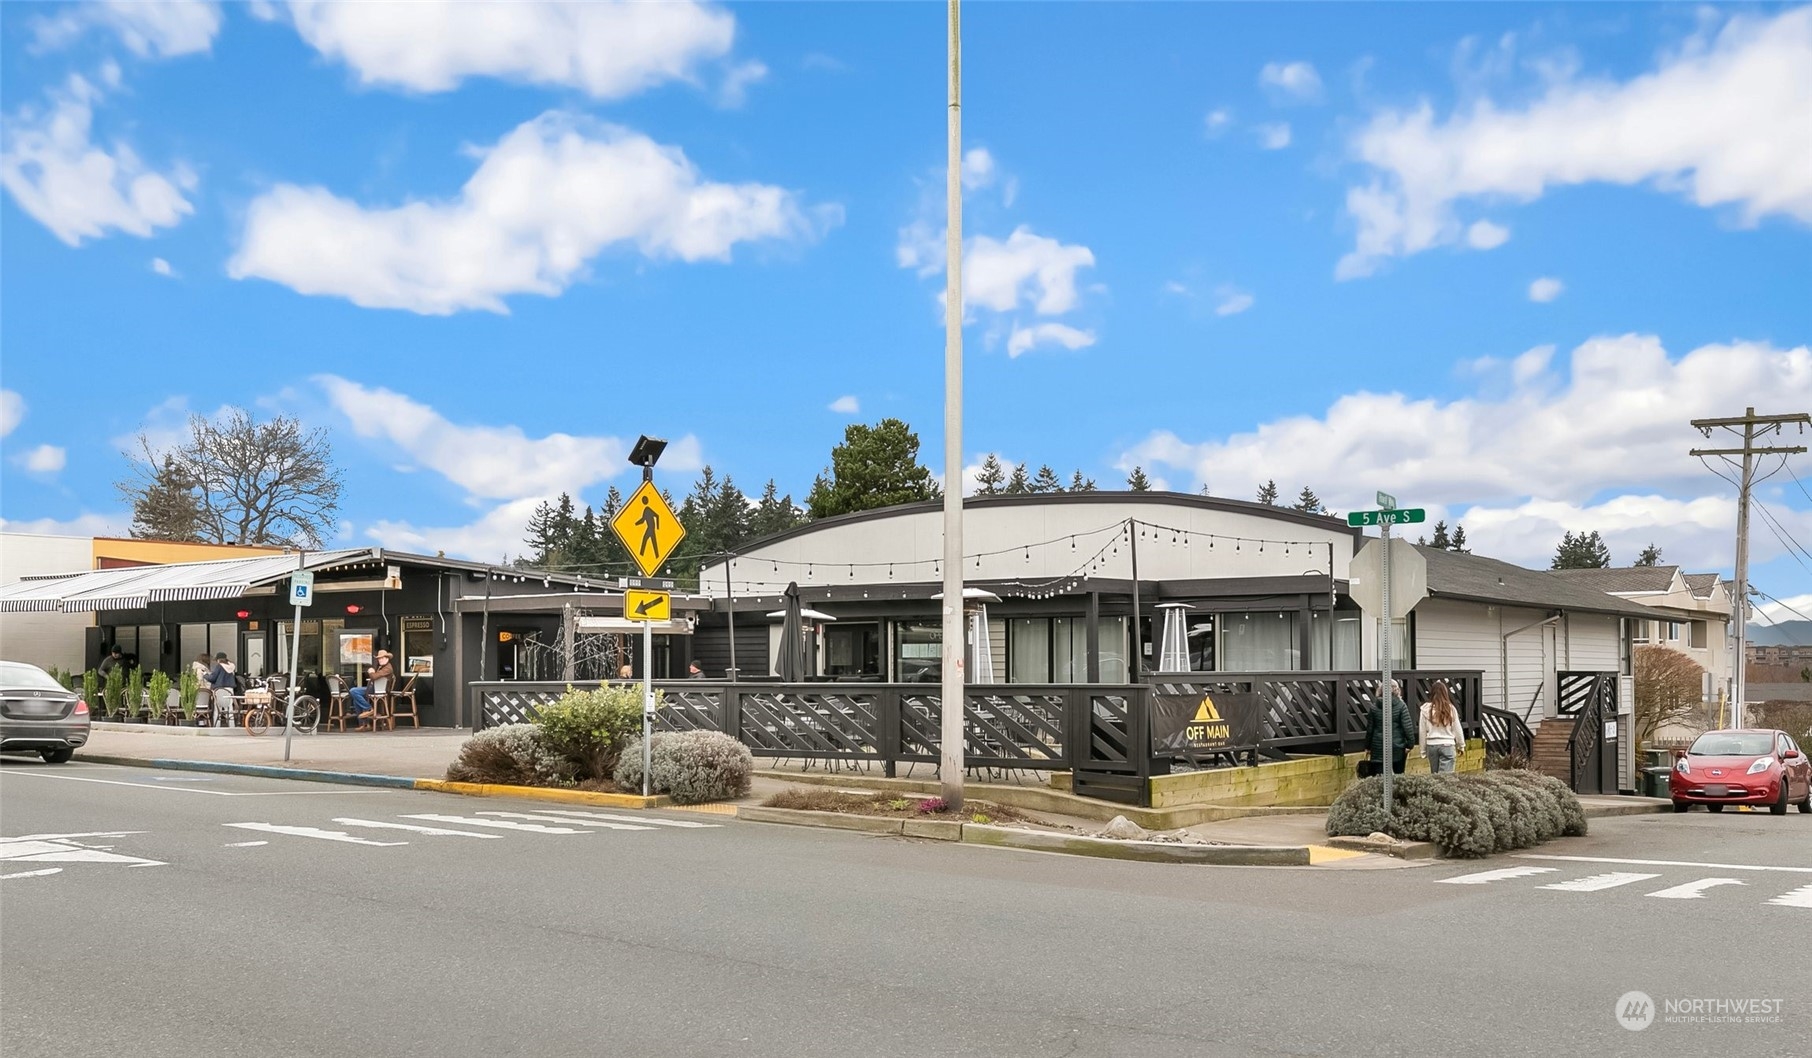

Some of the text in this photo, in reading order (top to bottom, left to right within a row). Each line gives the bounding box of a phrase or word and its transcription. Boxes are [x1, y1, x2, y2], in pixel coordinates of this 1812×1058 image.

[1363, 510, 1410, 525] 5 Ave S
[406, 621, 430, 629] ESPRESSO
[930, 632, 943, 640] OPE
[1186, 725, 1229, 740] OFF MAIN
